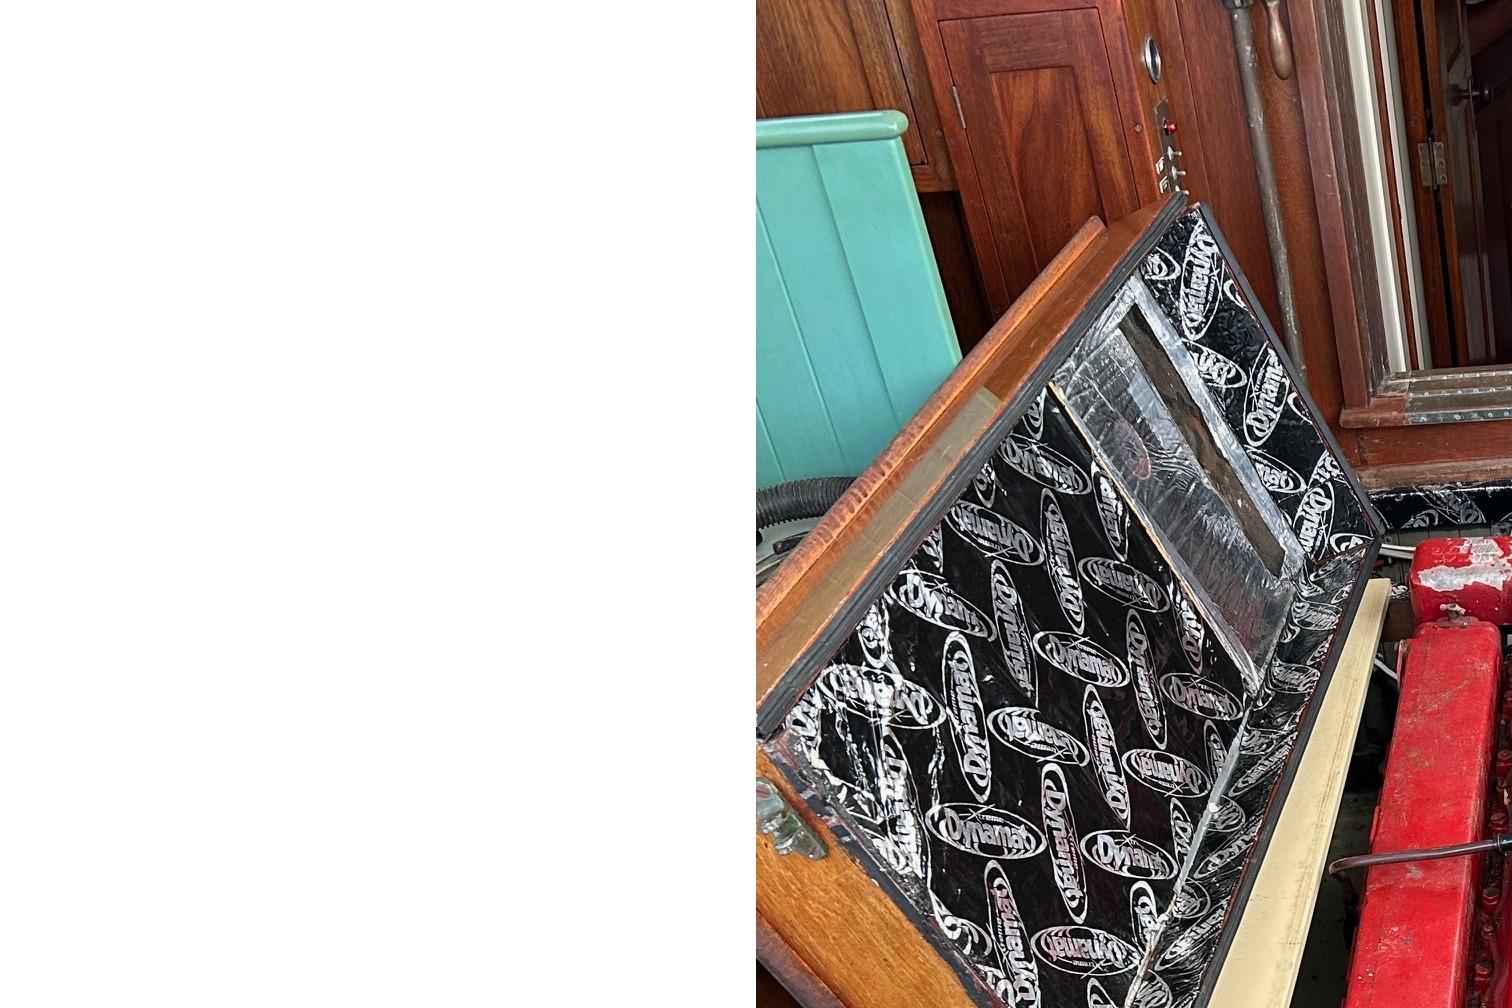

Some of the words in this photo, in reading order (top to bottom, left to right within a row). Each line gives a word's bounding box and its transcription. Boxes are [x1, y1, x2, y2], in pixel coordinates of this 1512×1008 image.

[1245, 347, 1285, 430] Dynama
[950, 504, 1030, 562] Dynamat
[1296, 492, 1330, 554] Dynam
[1043, 507, 1080, 617] Dynamat
[1091, 560, 1160, 608] Dynamat
[995, 581, 1033, 694] Dynamat
[1048, 634, 1120, 683] Dynamat
[1130, 628, 1160, 732] Dynamat
[944, 655, 985, 777] Dynamat
[1001, 711, 1076, 757] Dynamat
[1087, 703, 1125, 812] Dynamat
[1134, 753, 1200, 793] Dynamat
[941, 809, 1032, 849] Dynamat
[966, 806, 1004, 824] Xtreme
[1046, 787, 1083, 900] Dynamat
[1095, 834, 1167, 878] Dynamat
[990, 884, 1035, 1003] Dynamat
[1045, 933, 1124, 965] Dynamat
